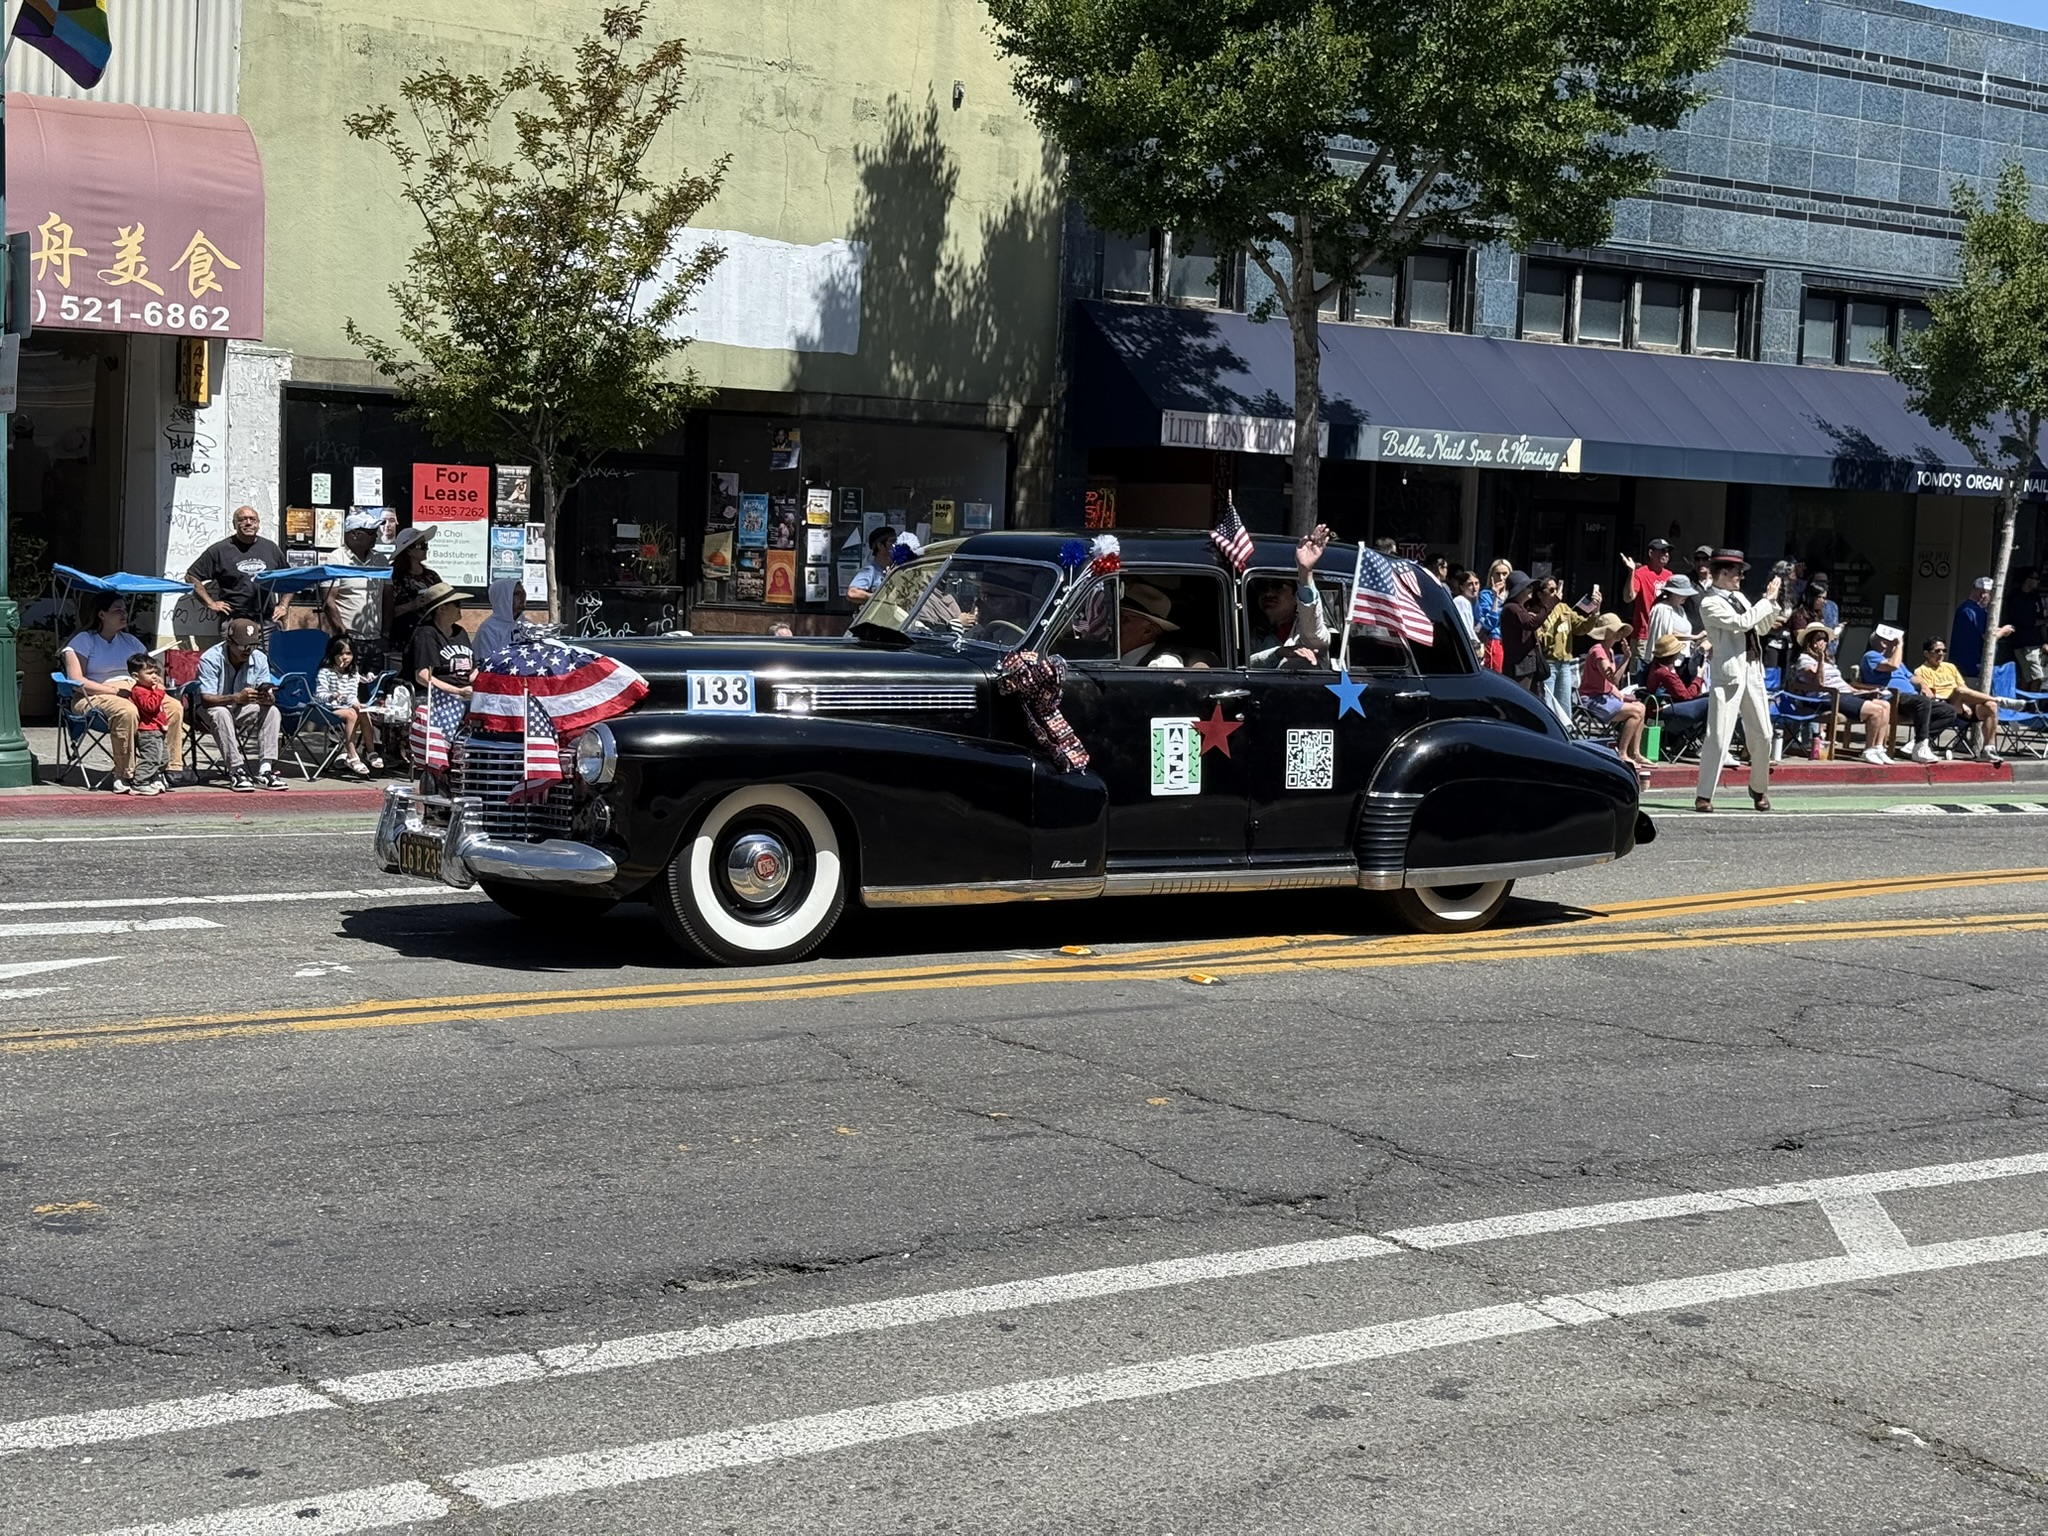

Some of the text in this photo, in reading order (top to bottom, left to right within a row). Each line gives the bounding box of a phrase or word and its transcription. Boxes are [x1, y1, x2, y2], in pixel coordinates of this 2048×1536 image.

[60, 294, 230, 331] 521-6862
[1382, 429, 1559, 471] Bella Nail Spa & Waxing
[436, 468, 468, 484] For
[1917, 471, 1961, 488] TOMO'S
[424, 485, 478, 502] Lease
[417, 505, 484, 518] 415.395.7262
[935, 503, 951, 511] IMP
[444, 530, 463, 538] Choi
[433, 551, 478, 559] Badstubner
[697, 676, 748, 705] 133
